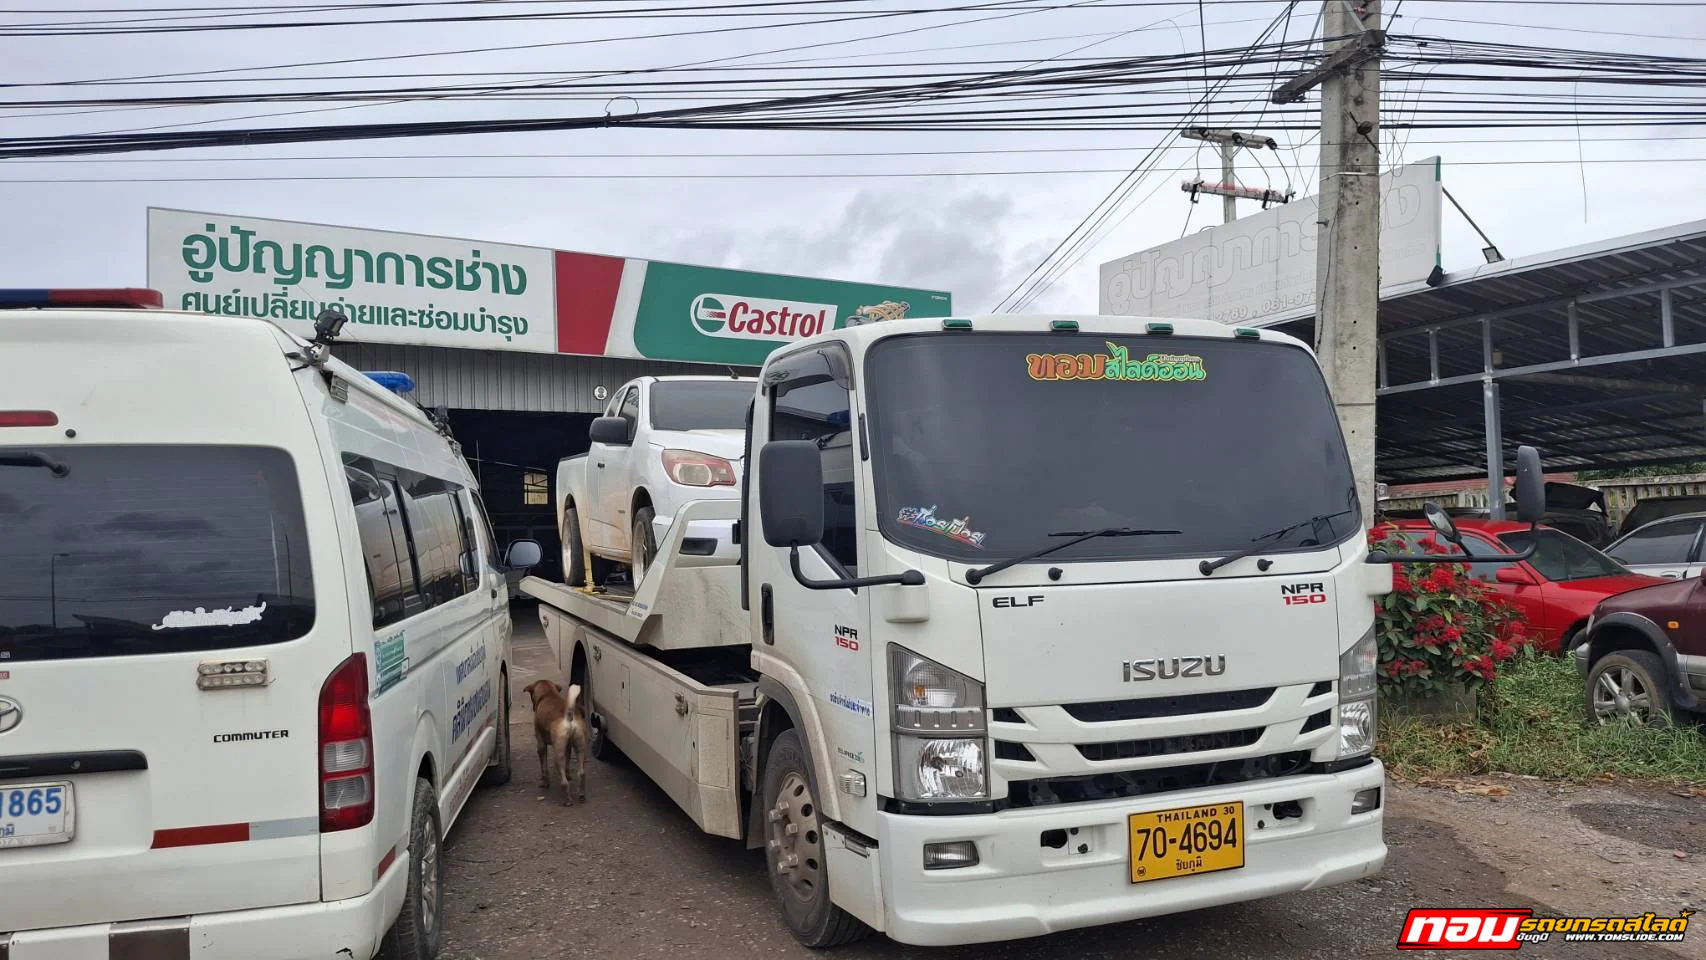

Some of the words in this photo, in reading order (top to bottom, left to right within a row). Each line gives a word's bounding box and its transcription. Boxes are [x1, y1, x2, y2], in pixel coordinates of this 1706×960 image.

[182, 223, 528, 296] อู่ปัญญาการช่าง
[182, 287, 528, 342] ศนย์เปลี่ยนถ่ายและซ่อมบำรุง
[728, 301, 826, 338] Castrol
[1281, 582, 1324, 595] NPR
[992, 595, 1045, 609] ELF
[1283, 593, 1326, 605] 150
[834, 624, 858, 640] NPR
[834, 636, 859, 651] 150
[1123, 653, 1226, 683] ISUZU
[213, 729, 289, 743] COMMUTER
[1157, 808, 1218, 823] THAILAND
[1223, 806, 1235, 815] 30
[1137, 817, 1237, 861] 70-4694
[1176, 856, 1203, 872] ชัยภูมิ
